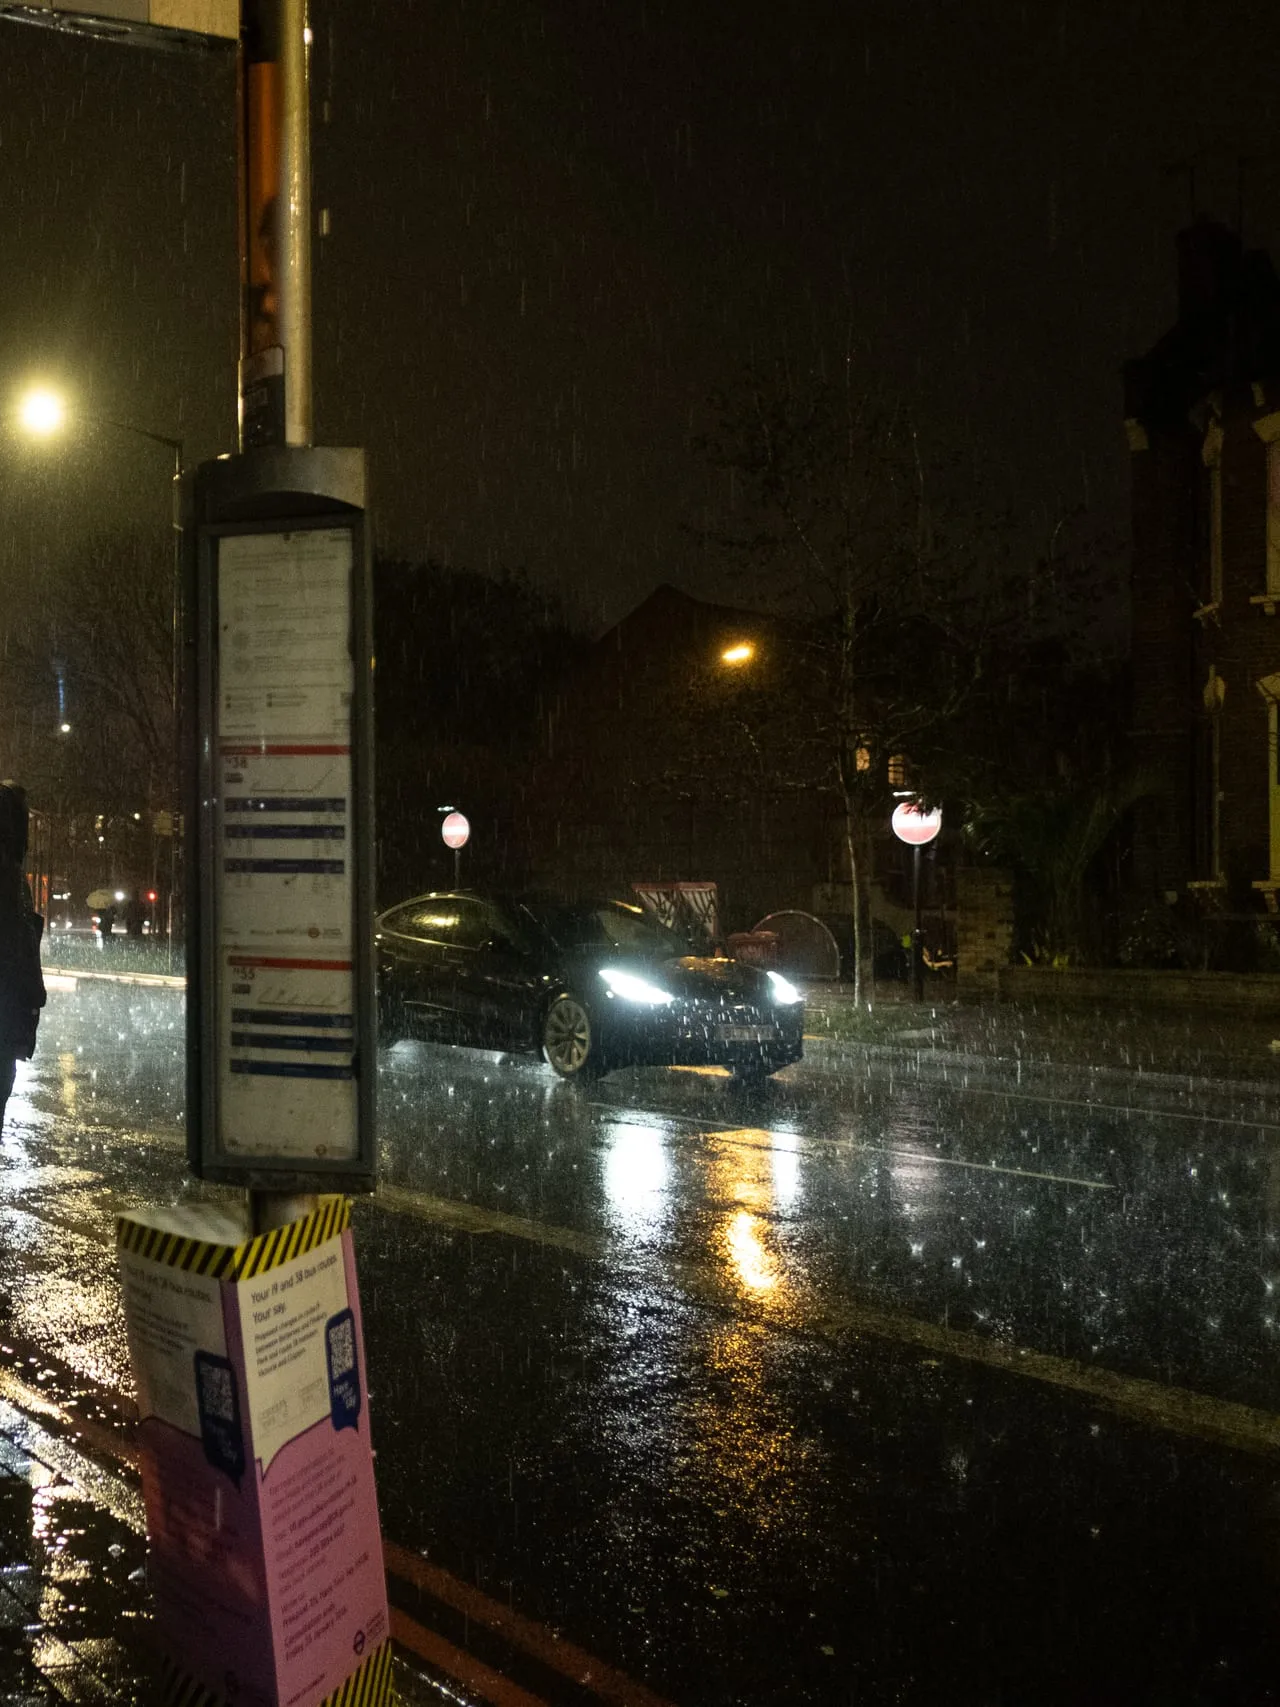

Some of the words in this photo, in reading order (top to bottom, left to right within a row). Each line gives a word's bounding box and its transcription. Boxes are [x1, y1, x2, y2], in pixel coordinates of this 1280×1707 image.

[251, 1288, 270, 1304] Your
[280, 1276, 295, 1293] and
[304, 1265, 317, 1279] bus
[317, 1254, 338, 1272] routes
[252, 1305, 271, 1325] Your
